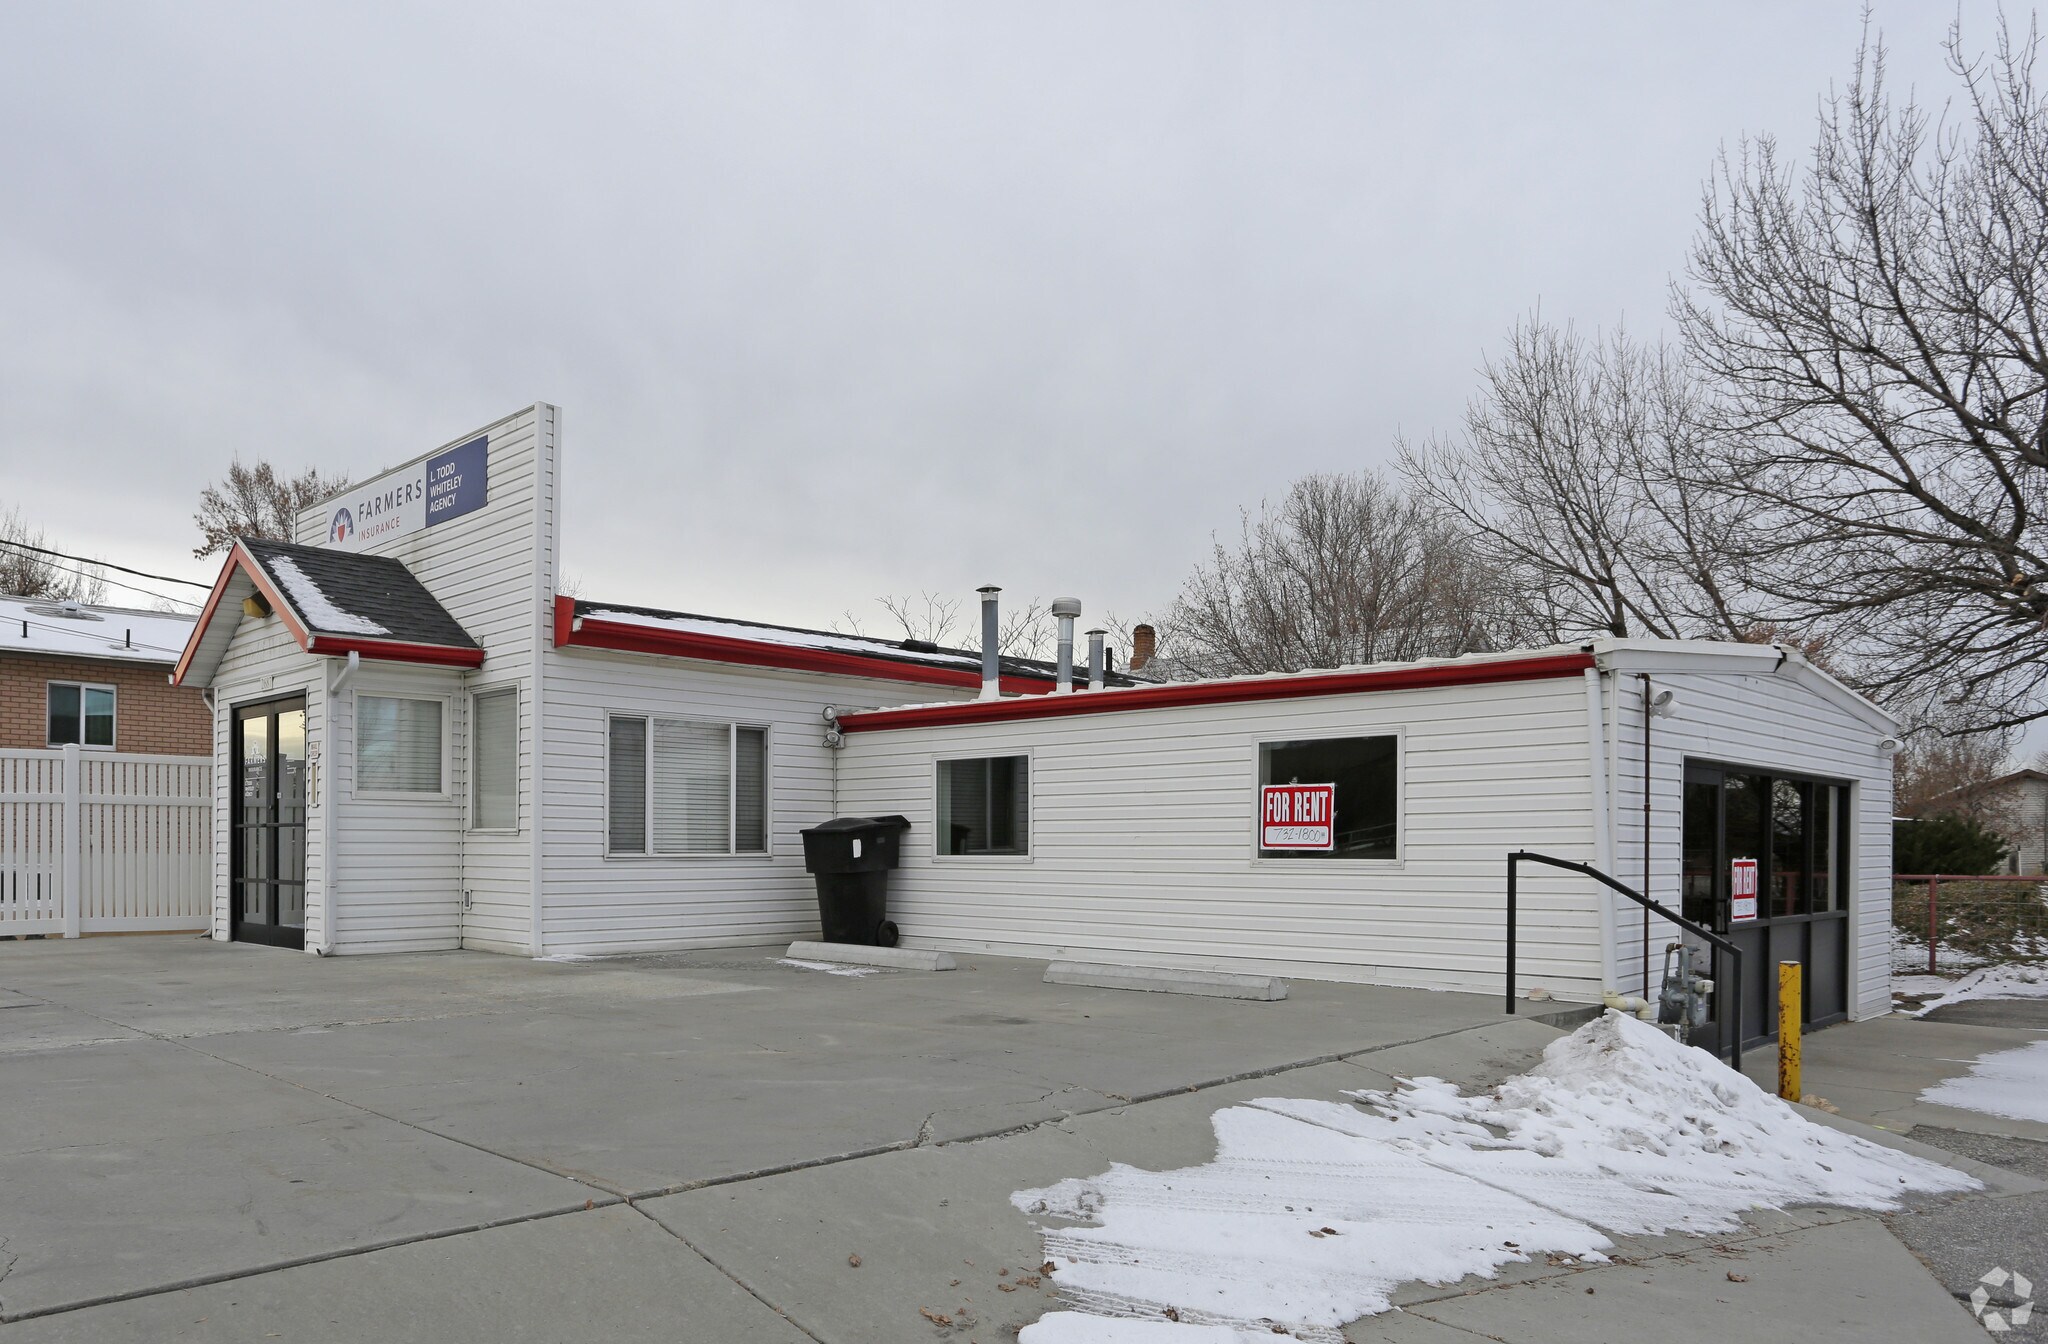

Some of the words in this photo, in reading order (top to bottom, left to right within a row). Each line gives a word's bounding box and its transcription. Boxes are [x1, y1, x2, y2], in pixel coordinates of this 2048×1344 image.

[436, 462, 456, 479] TODD
[429, 474, 463, 498] WHITELEY
[358, 479, 422, 523] FARMERS
[429, 492, 457, 514] AGENCY
[358, 516, 400, 542] INSURANCE
[1266, 792, 1290, 822] FOR
[1294, 791, 1328, 822] RENT
